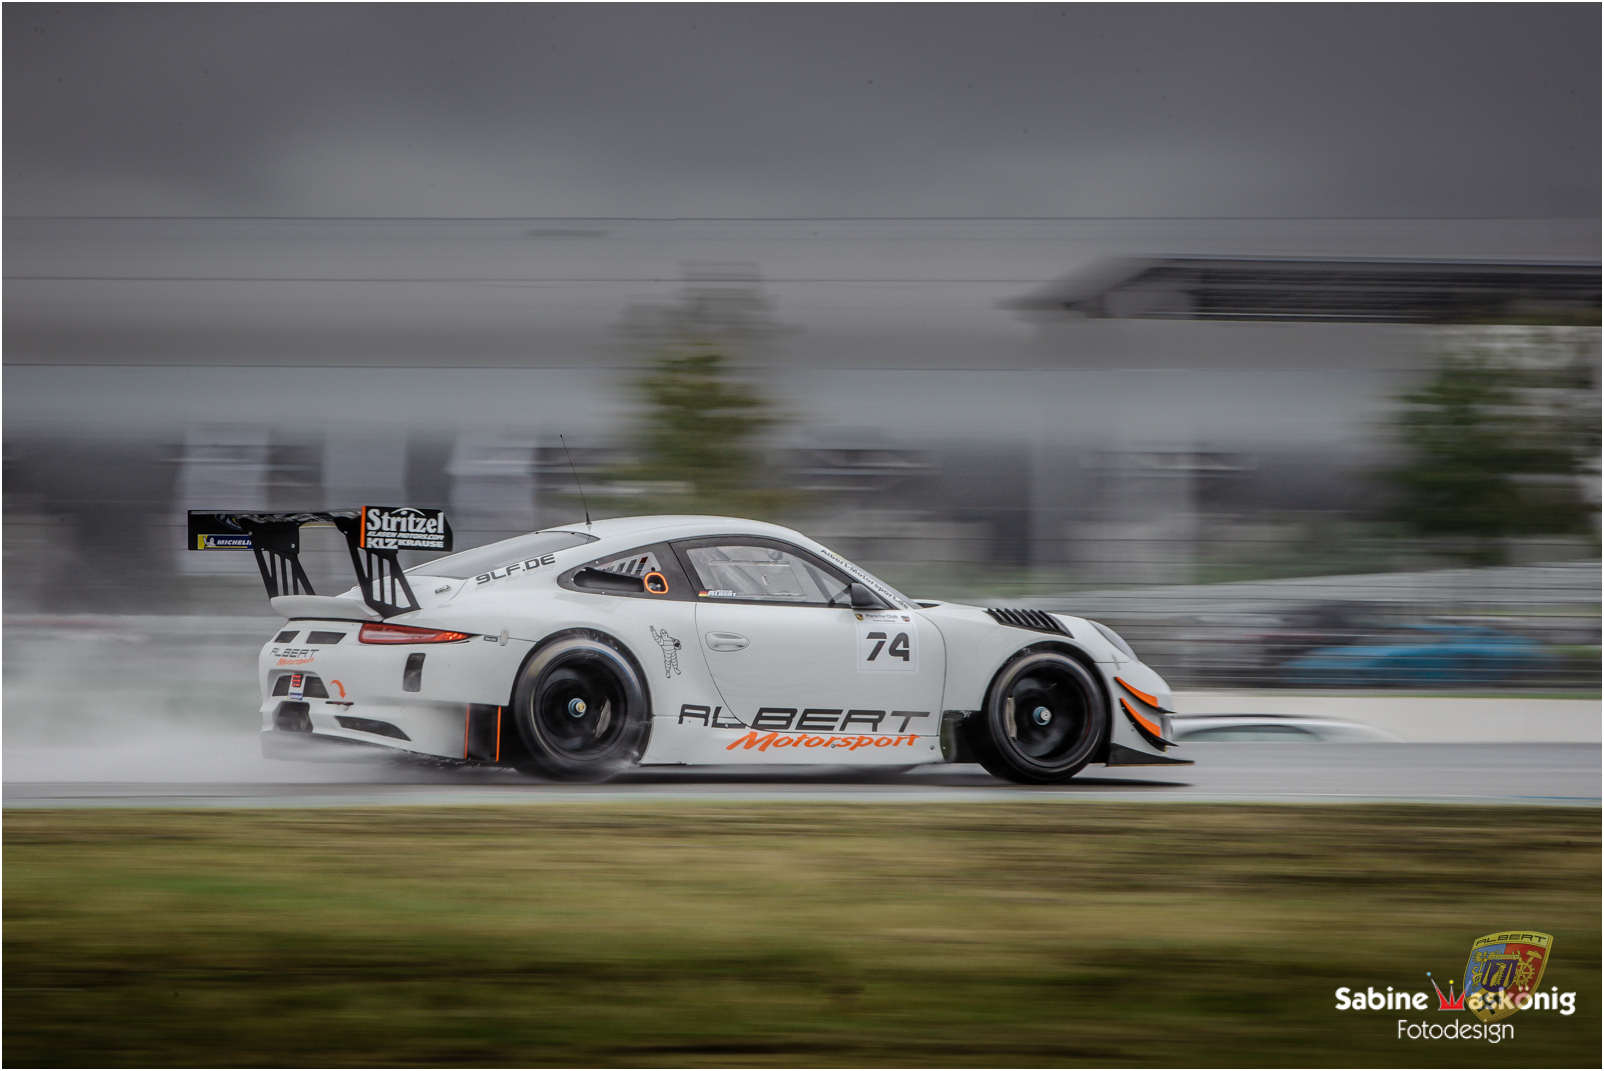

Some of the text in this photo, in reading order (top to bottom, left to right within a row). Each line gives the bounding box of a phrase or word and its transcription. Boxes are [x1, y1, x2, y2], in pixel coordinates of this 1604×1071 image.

[366, 508, 444, 534] Stritzel
[398, 539, 444, 548] KRAUSE
[475, 553, 556, 585] 9LF.DE
[269, 647, 320, 658] ALBERT
[866, 631, 910, 662] 74
[276, 656, 315, 667] Motorsport
[678, 703, 931, 733] ALBERT
[726, 731, 921, 752] Motorsport
